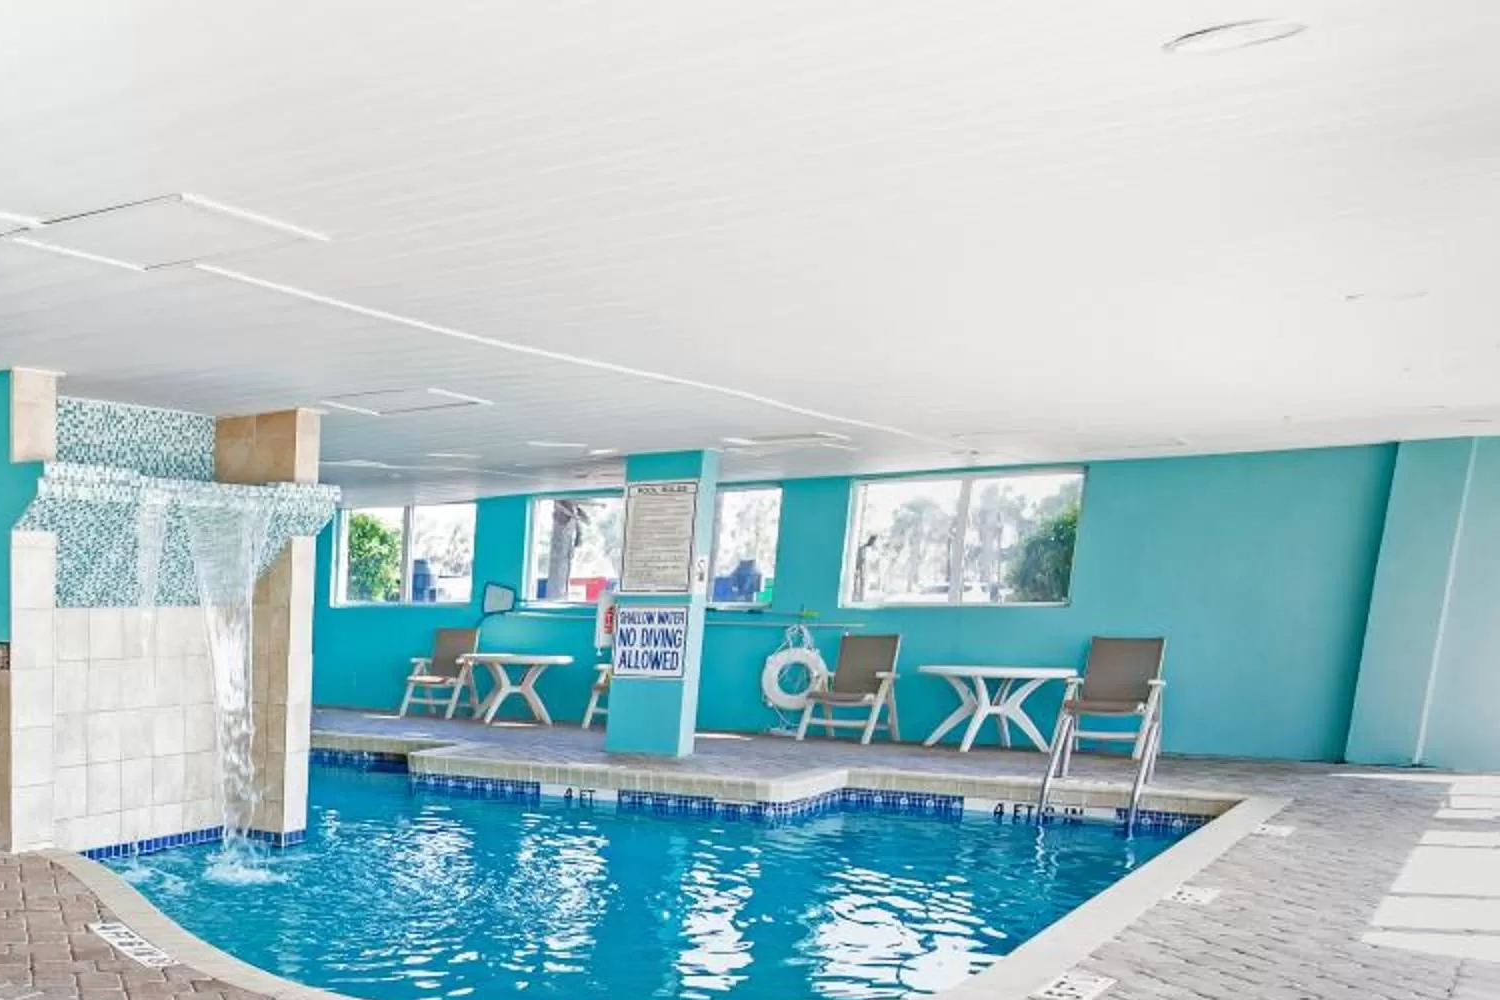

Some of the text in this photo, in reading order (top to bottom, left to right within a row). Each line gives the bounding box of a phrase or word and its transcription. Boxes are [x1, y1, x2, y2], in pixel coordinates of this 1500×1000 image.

[619, 611, 654, 625] SHALLOW
[657, 611, 684, 625] WATER
[617, 627, 683, 649] NO DIVING
[617, 650, 679, 671] ALLOWED
[580, 788, 597, 809] FT
[993, 803, 1005, 821] 4
[1012, 803, 1036, 824] FT
